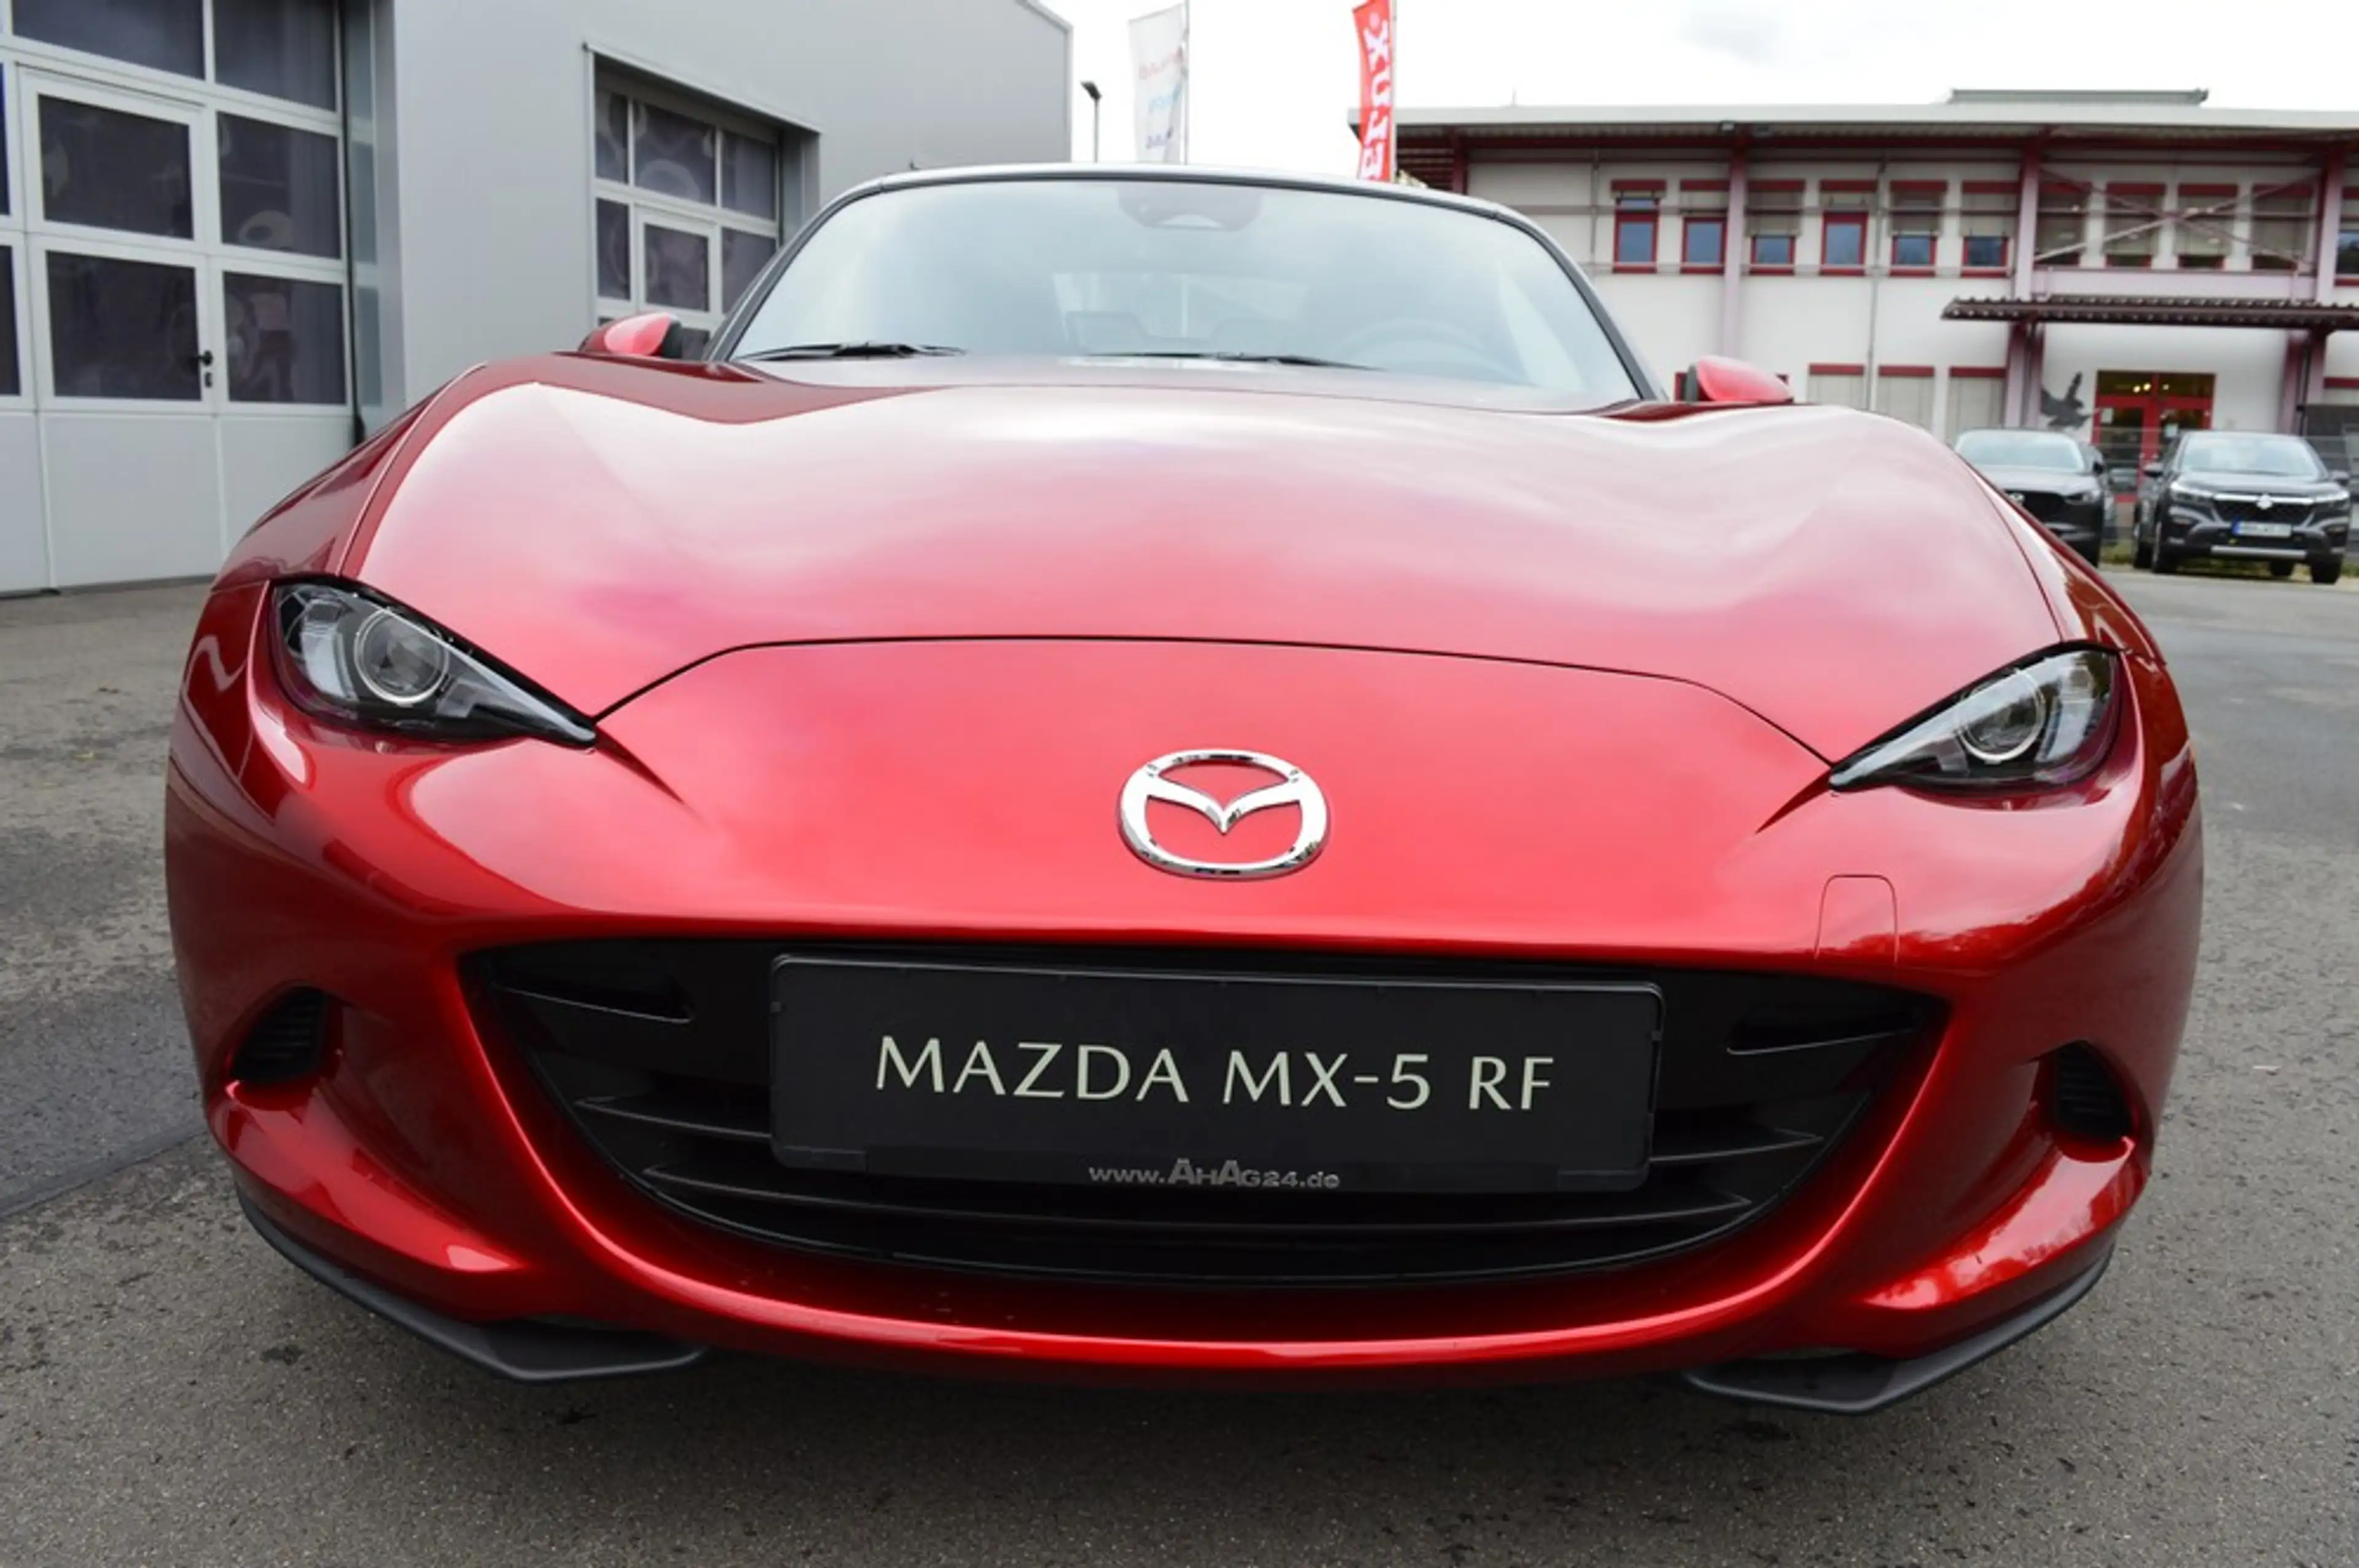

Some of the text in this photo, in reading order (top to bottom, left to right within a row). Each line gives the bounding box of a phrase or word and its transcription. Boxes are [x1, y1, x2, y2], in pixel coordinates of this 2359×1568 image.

[877, 1036, 1554, 1110] MAZDA MX-5 RF
